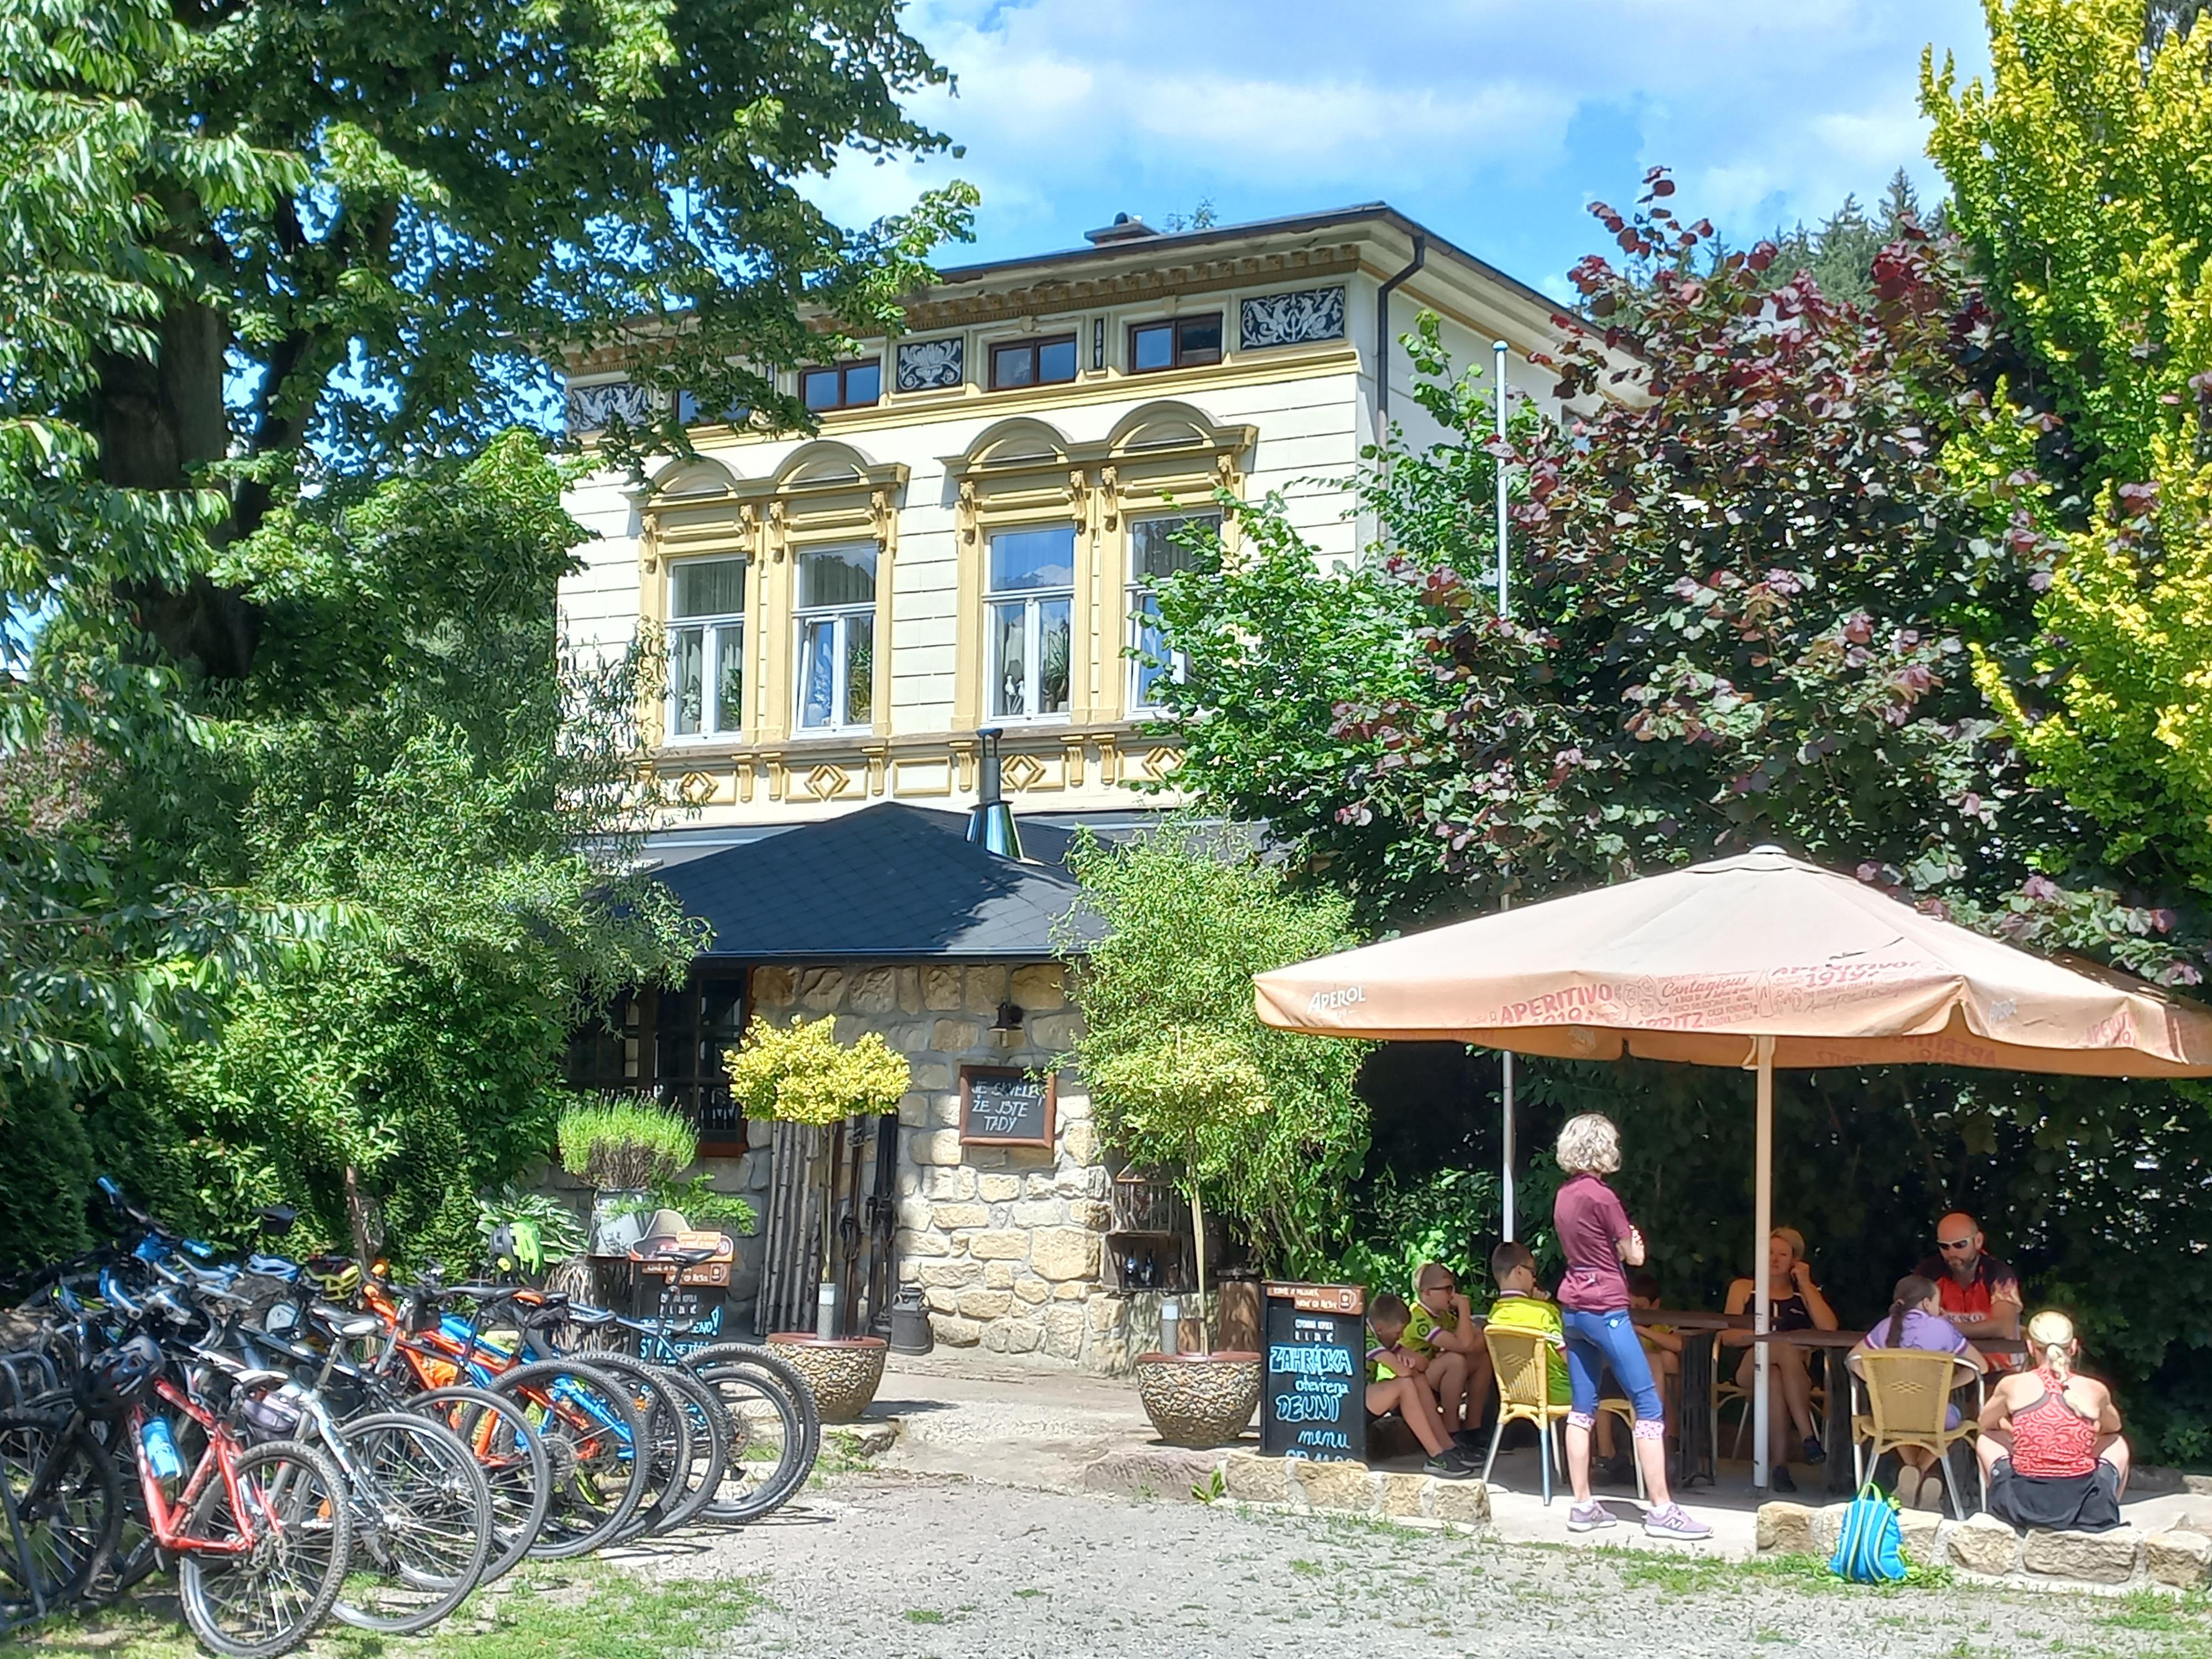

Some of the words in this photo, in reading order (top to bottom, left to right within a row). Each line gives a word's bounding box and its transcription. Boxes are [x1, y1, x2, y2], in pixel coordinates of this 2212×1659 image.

[1306, 985, 1366, 1015] APEROL
[1500, 983, 1613, 1025] APERITIVO
[971, 1081, 987, 1094] JE
[972, 1094, 990, 1113] ŽE
[994, 1100, 1029, 1117] JSTE
[984, 1115, 1018, 1134] TADY
[1297, 1430, 1351, 1449] menu
